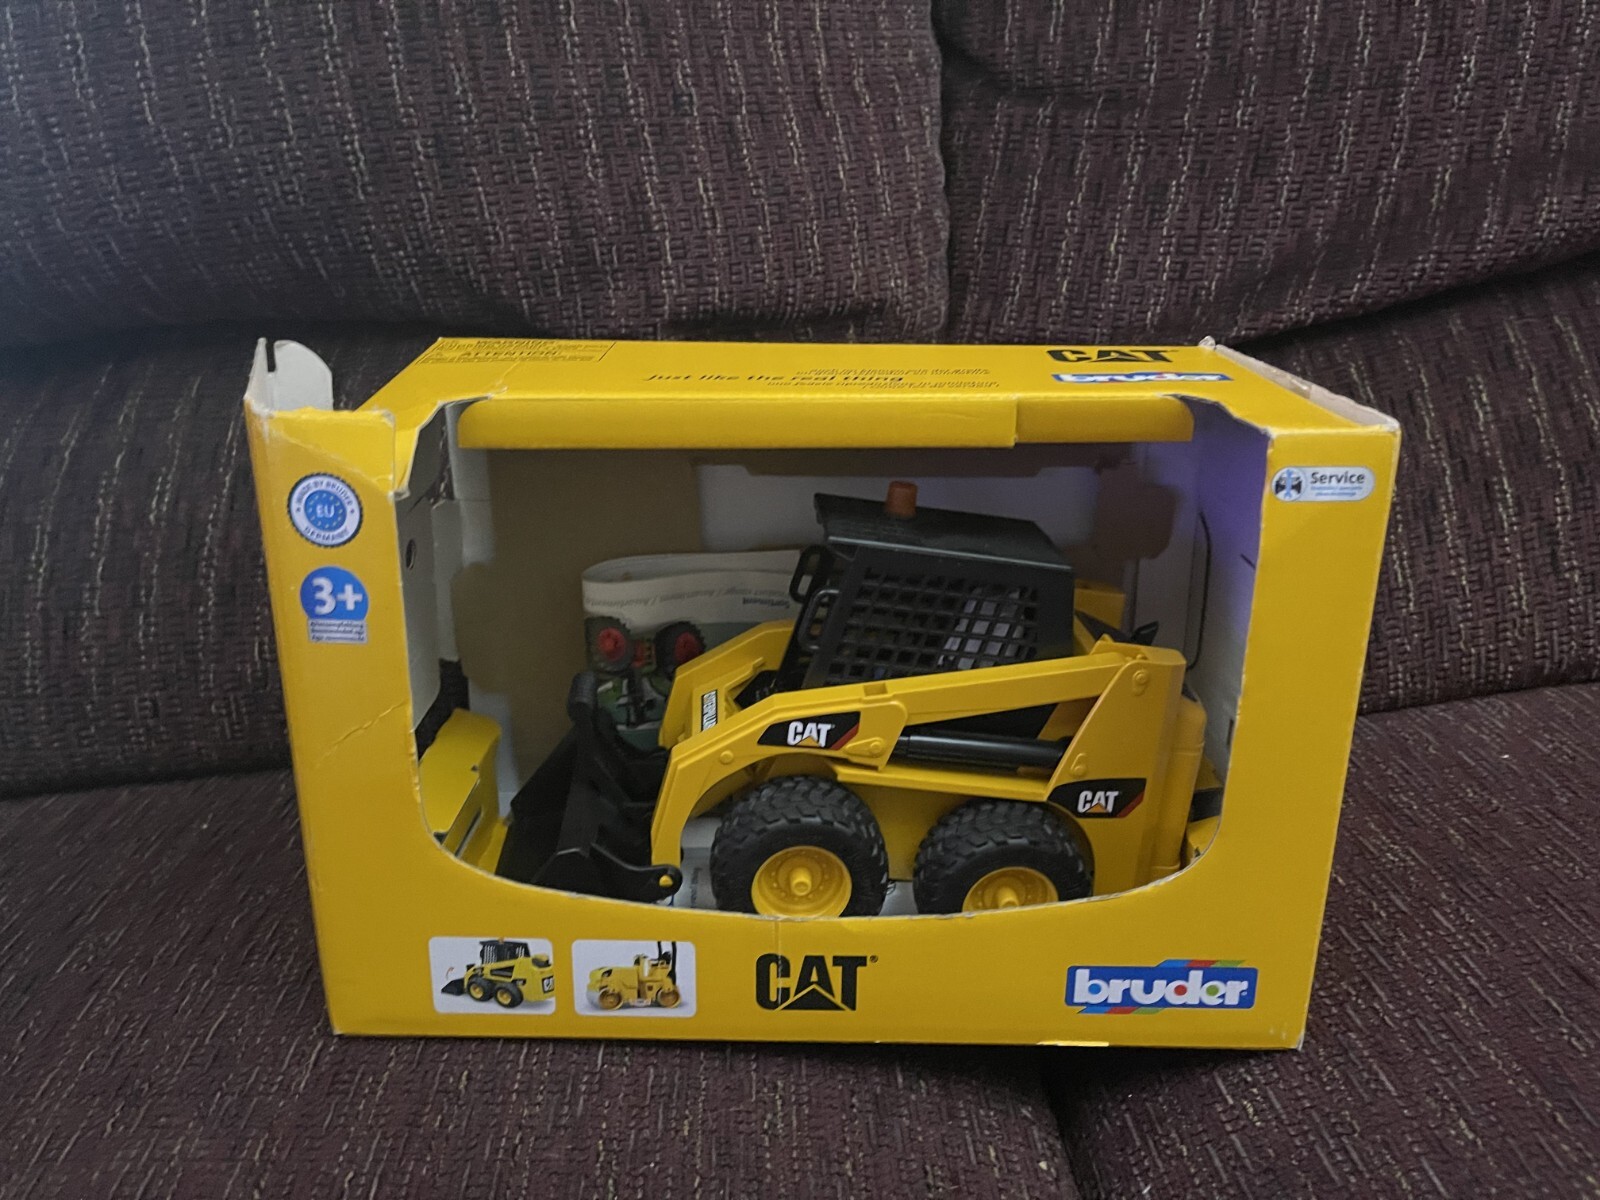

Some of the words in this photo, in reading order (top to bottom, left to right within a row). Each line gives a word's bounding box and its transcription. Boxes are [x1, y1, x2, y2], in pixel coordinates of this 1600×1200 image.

[1047, 349, 1173, 363] CAT
[1311, 471, 1365, 485] Service
[316, 504, 336, 519] EU
[312, 576, 363, 615] 3+
[787, 720, 831, 748] CAT
[1077, 790, 1119, 814] CAT
[756, 953, 867, 1011] CAT
[1073, 968, 1249, 1006] bruder
